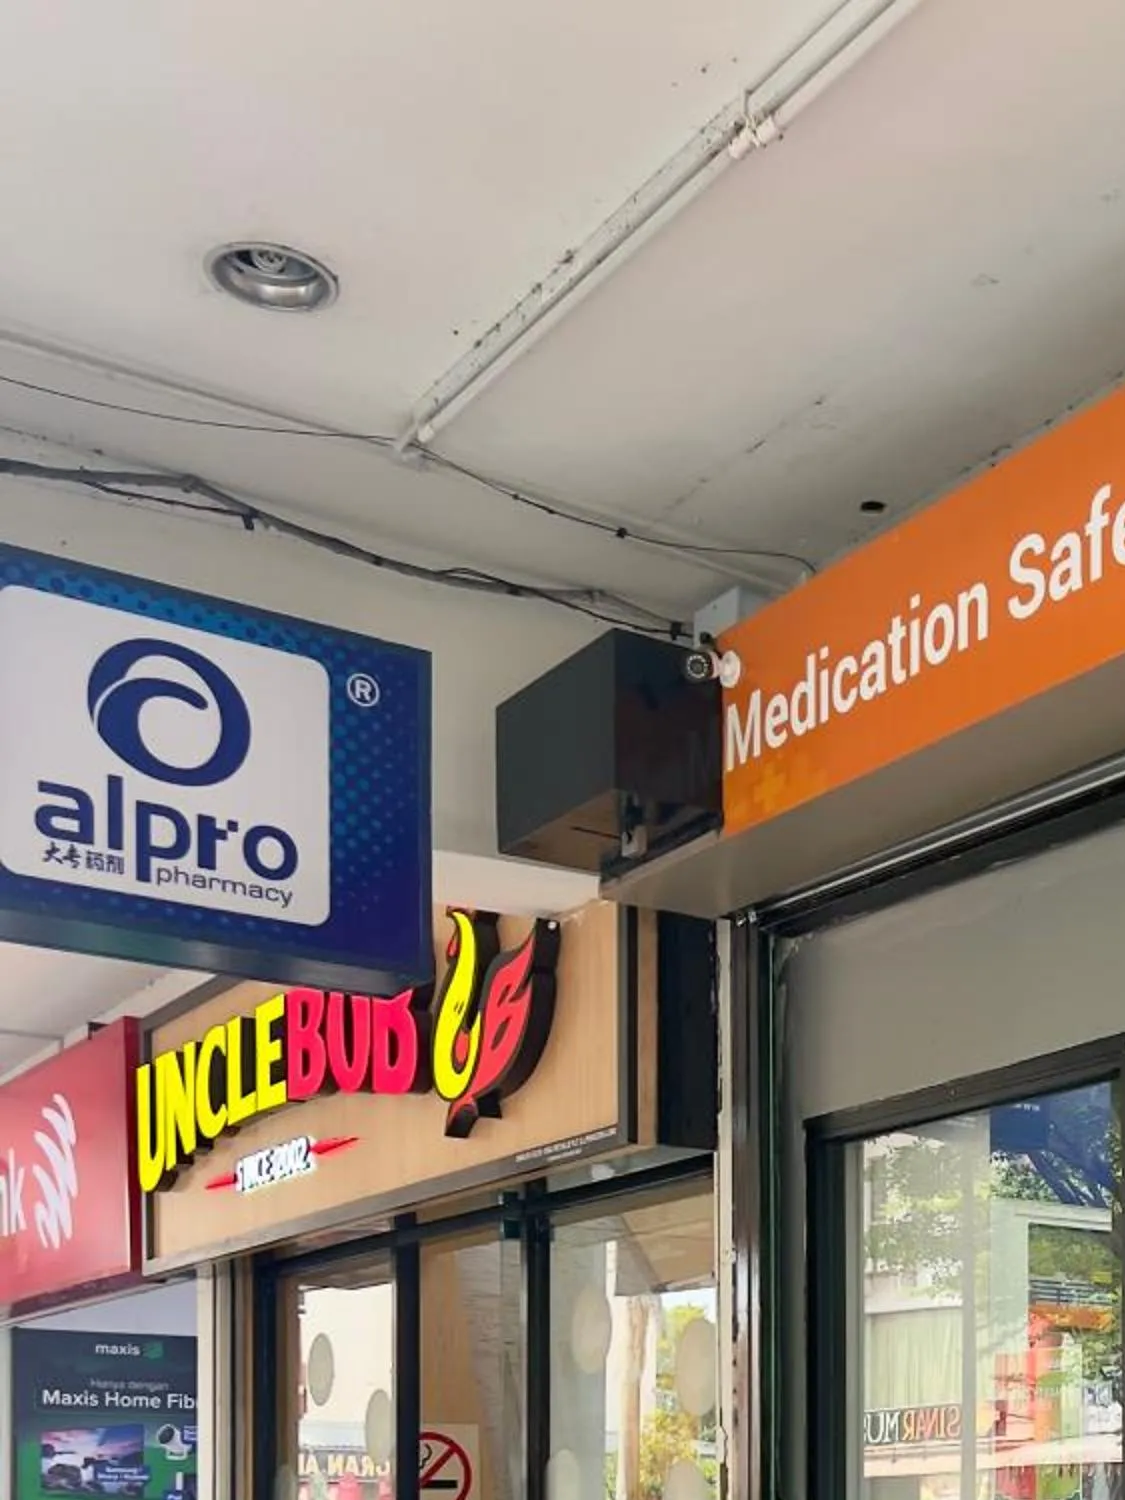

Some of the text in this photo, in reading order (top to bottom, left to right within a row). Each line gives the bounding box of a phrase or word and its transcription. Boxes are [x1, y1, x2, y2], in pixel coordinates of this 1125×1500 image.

[726, 581, 989, 771] Medication
[34, 774, 298, 883] alpro
[156, 866, 293, 908] pharmacy
[136, 993, 287, 1192] UNCLE
[95, 1343, 141, 1356] maxis
[42, 1389, 198, 1410] Maxis Home Fib
